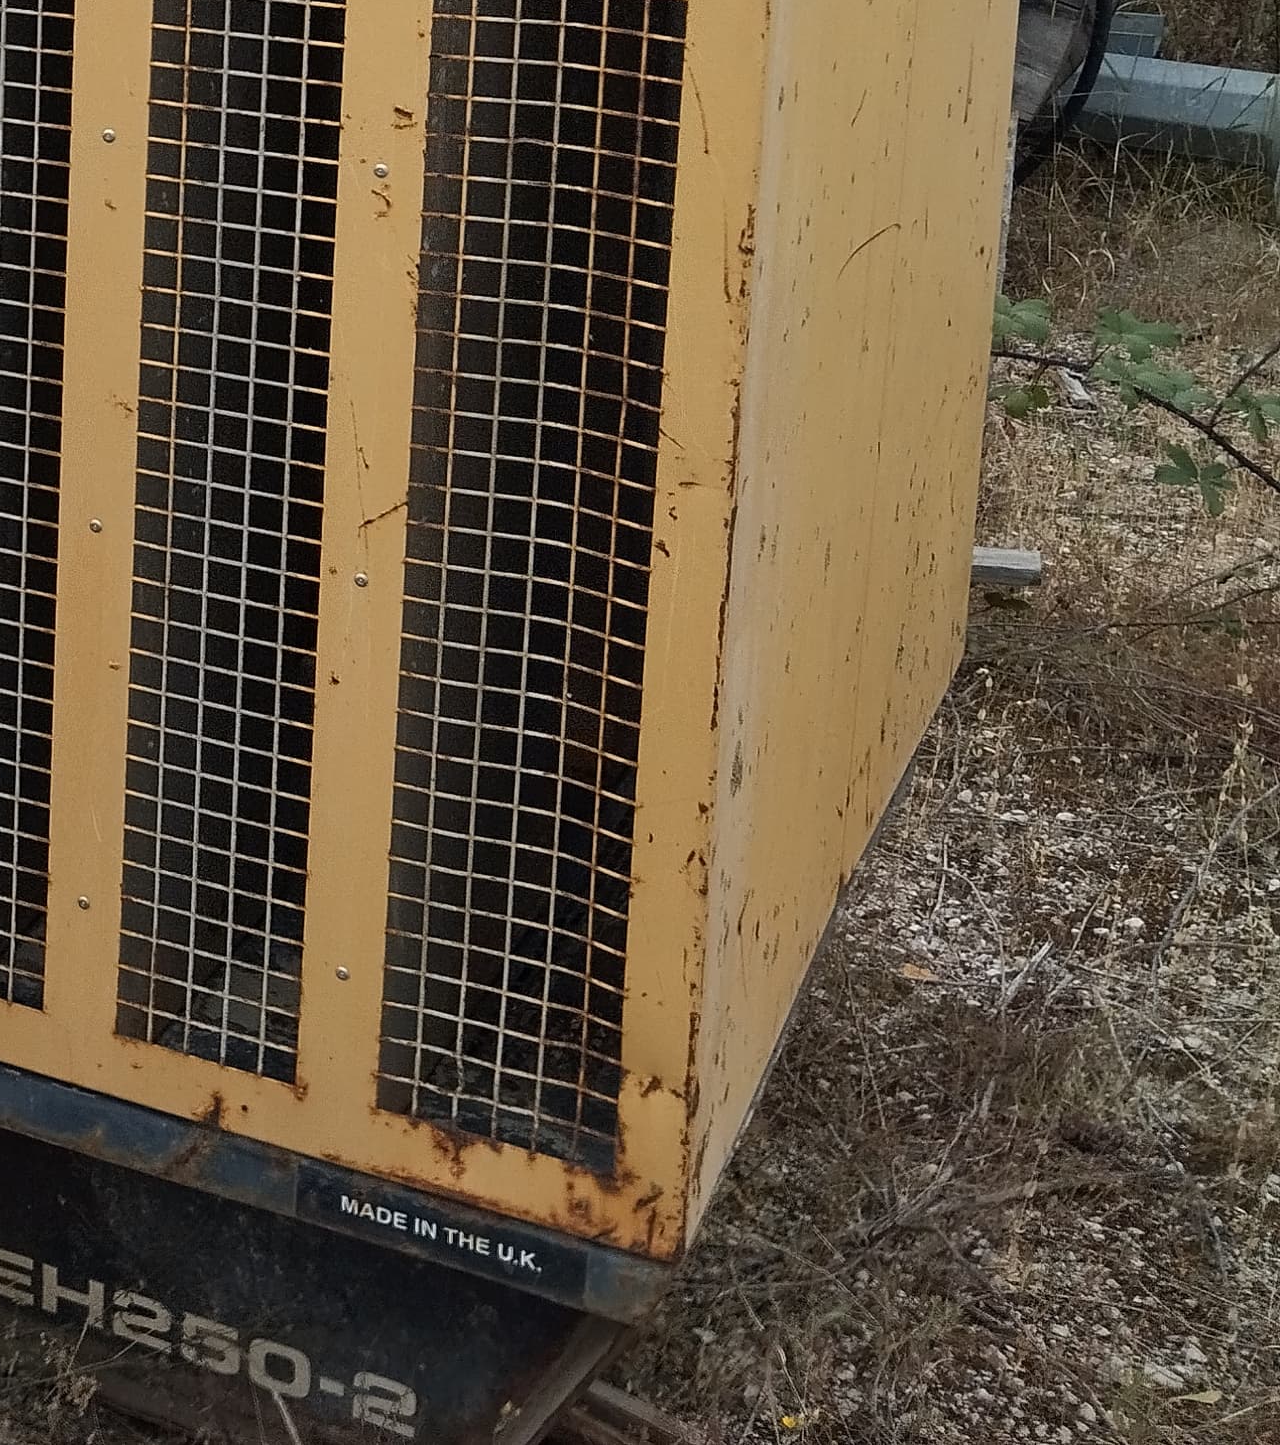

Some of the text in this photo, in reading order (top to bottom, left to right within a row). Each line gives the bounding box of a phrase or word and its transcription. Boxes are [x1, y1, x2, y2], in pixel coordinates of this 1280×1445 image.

[340, 1195, 543, 1273] MADE IN THE U.K.
